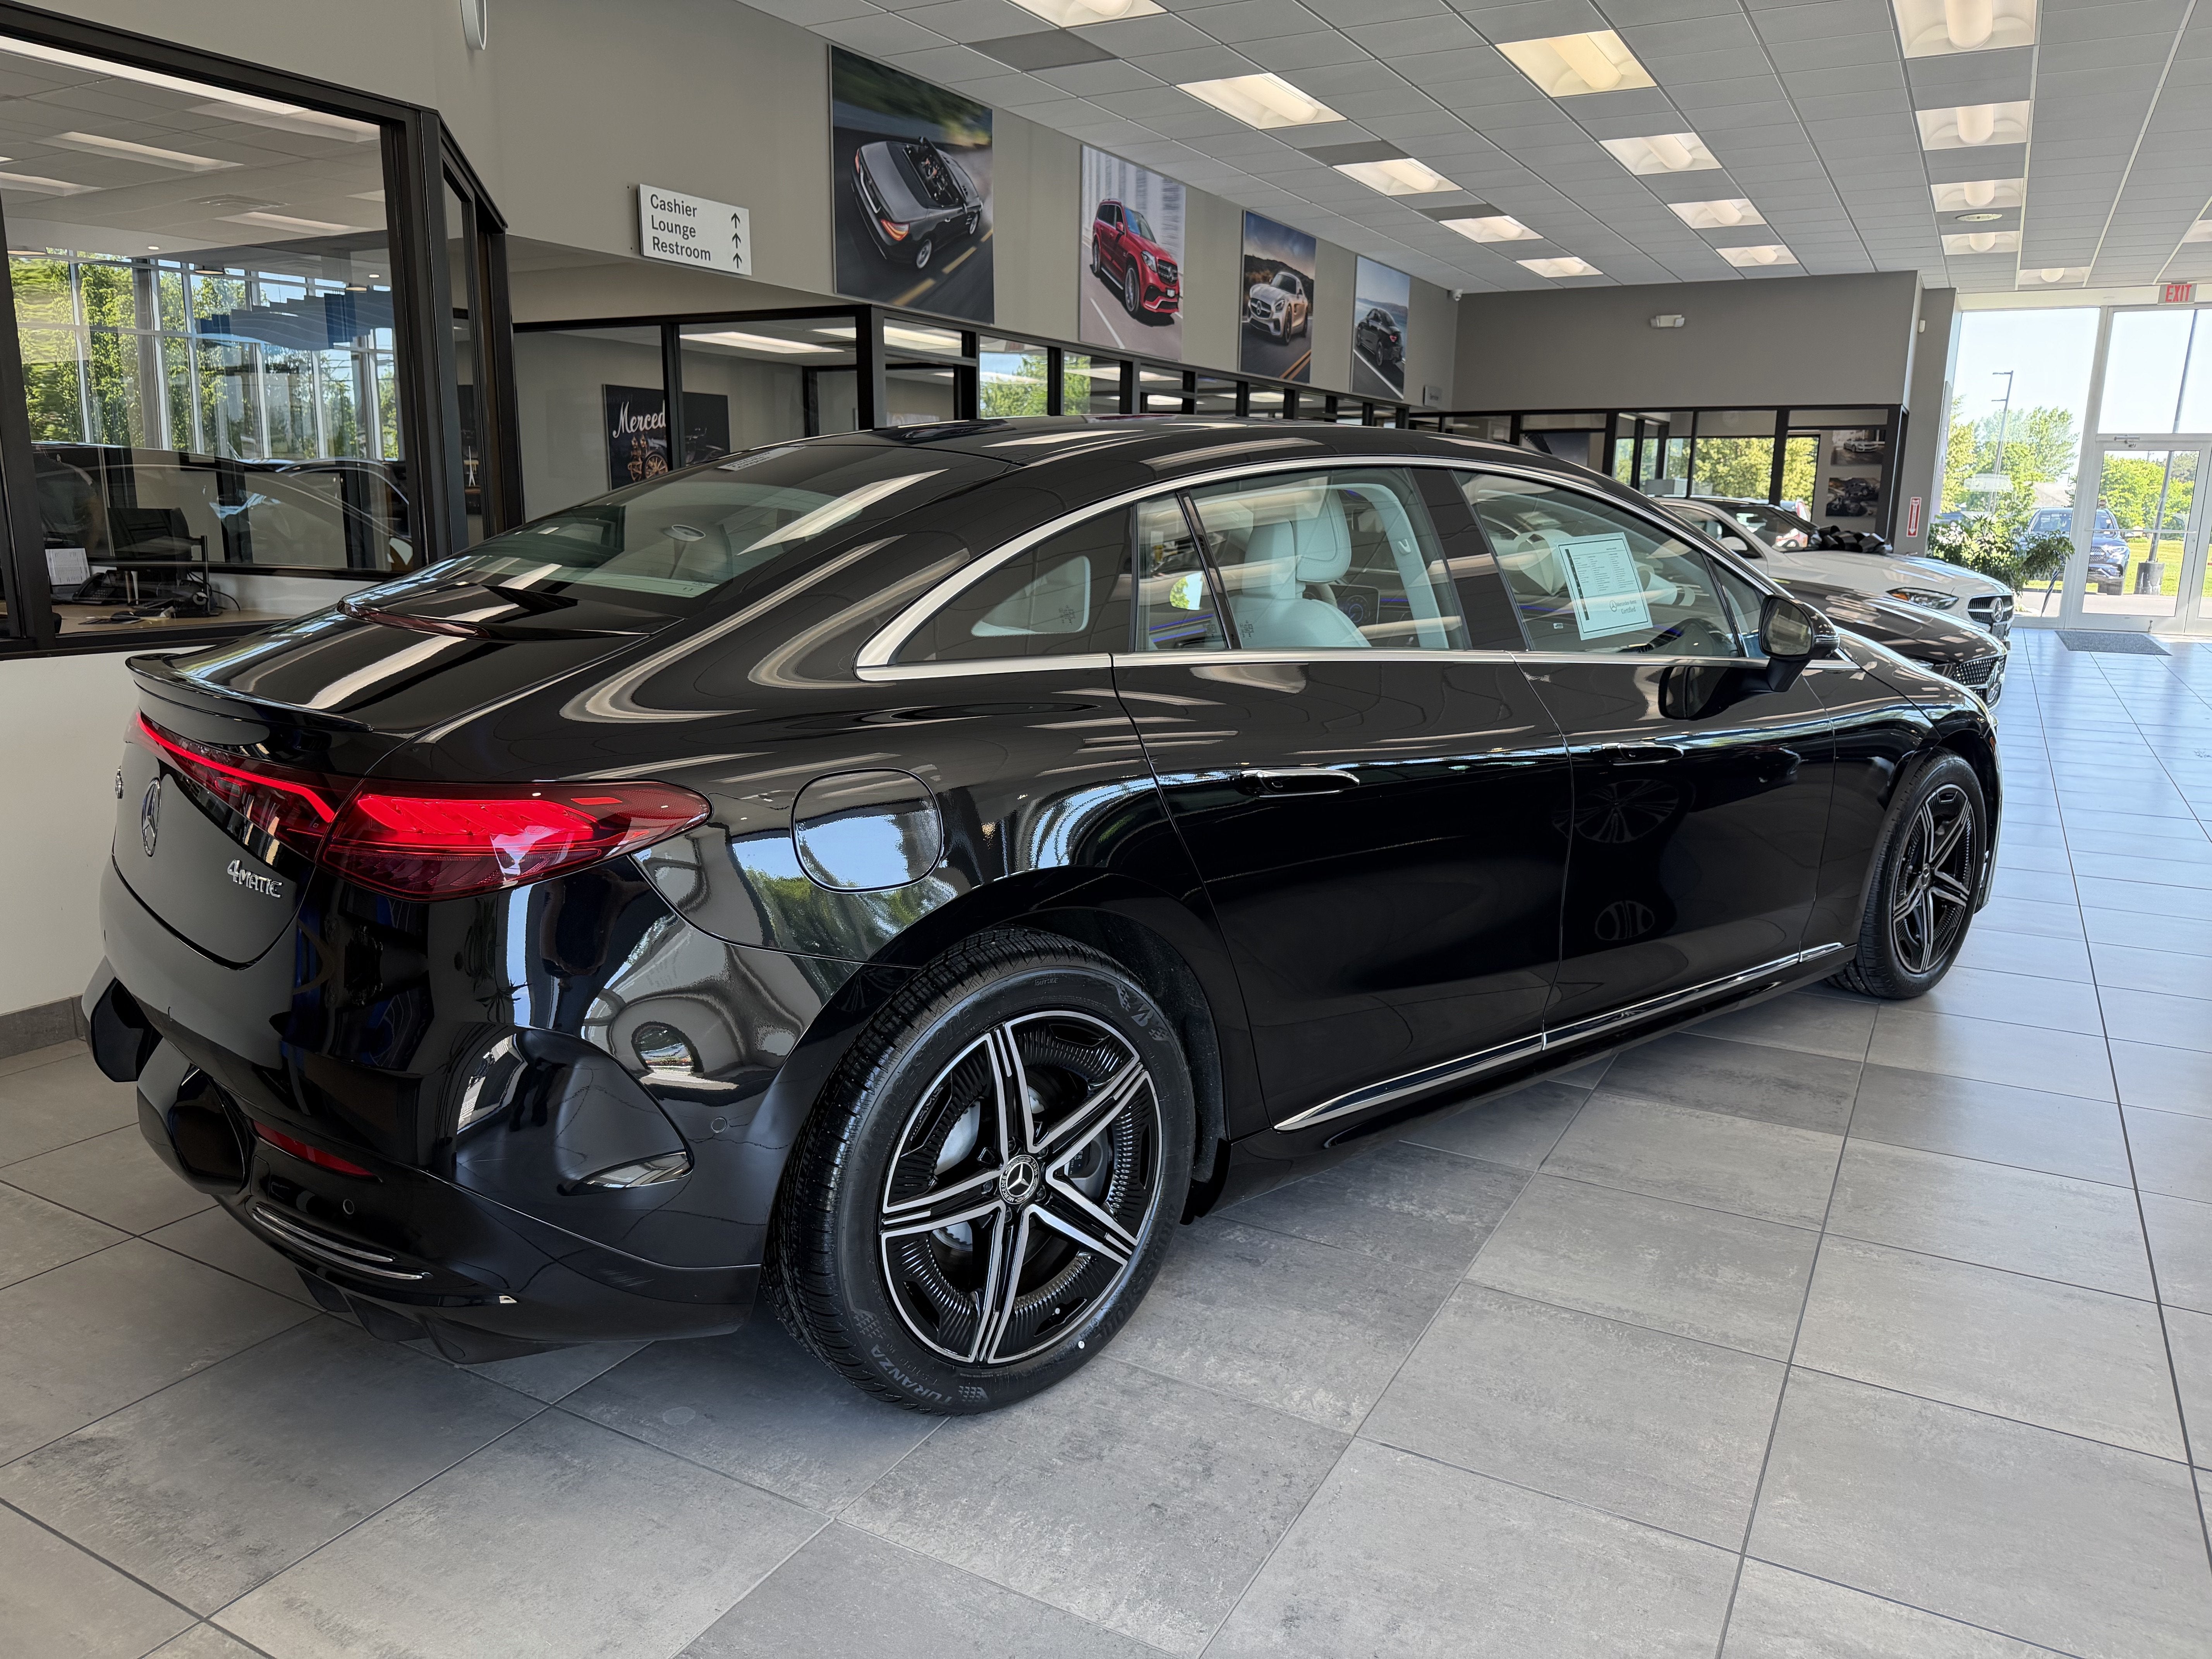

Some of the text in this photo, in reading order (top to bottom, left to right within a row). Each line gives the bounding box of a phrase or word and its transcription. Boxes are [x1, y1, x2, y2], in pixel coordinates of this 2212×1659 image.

[650, 194, 697, 217] Cashier
[651, 215, 696, 240] Lounge
[652, 236, 711, 261] Restroom
[2165, 285, 2192, 302] EXIT
[227, 859, 282, 898] 4MATIC
[1001, 1175, 1014, 1202] MERCEDES
[870, 1343, 953, 1405] TURANZA
